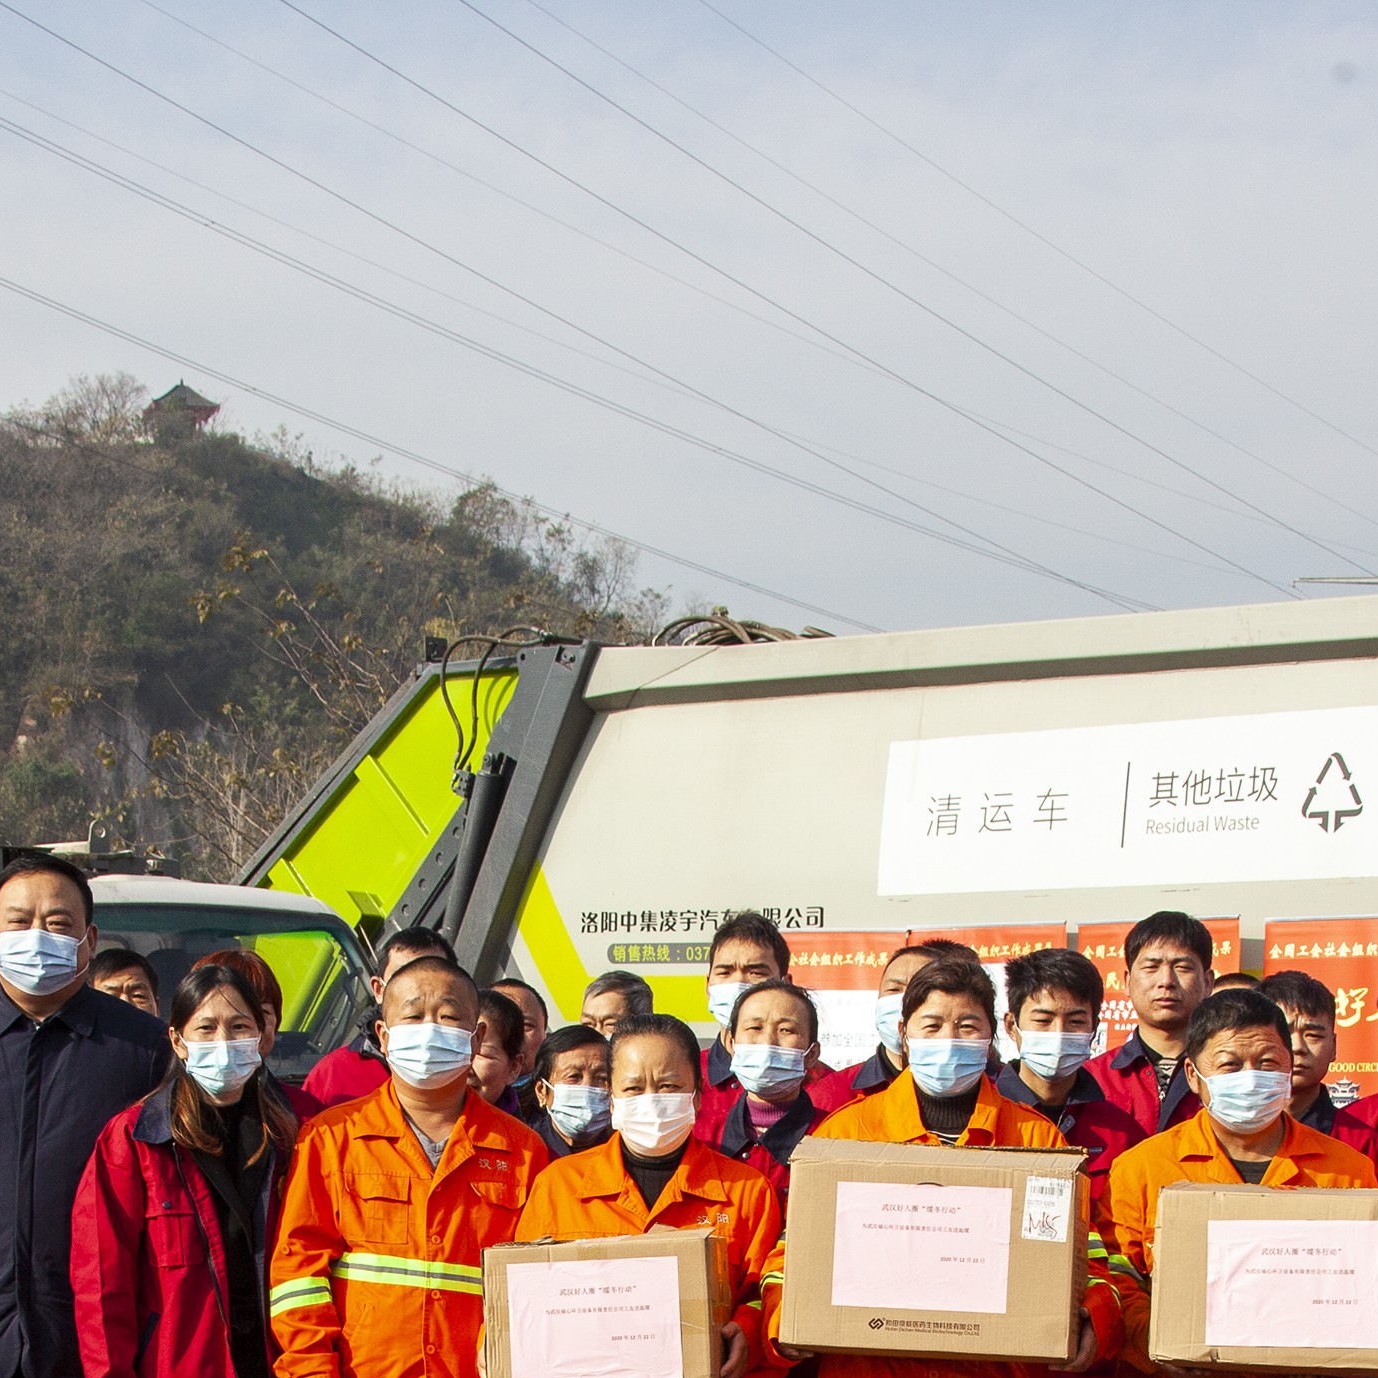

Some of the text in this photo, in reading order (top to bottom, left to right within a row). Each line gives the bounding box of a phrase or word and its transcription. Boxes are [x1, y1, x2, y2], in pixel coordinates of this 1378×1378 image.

[1148, 766, 1279, 808] 其他垃圾
[925, 787, 1070, 837] 清运车
[1146, 813, 1260, 836] Residual Waste
[1328, 1062, 1355, 1073] GOOD
[697, 1212, 729, 1225] 汉阳
